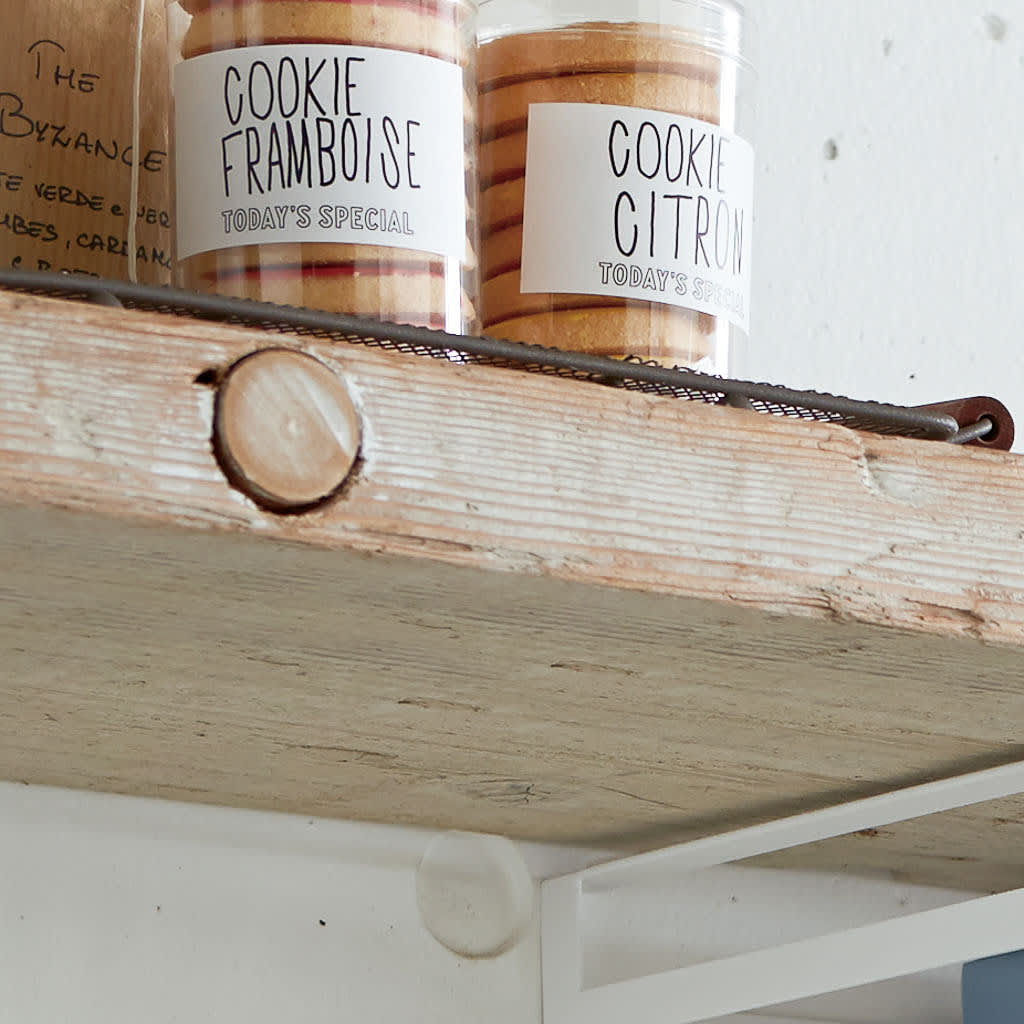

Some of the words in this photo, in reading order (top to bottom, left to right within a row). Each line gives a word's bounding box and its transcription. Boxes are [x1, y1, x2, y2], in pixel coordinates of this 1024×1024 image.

[28, 40, 100, 93] THE
[224, 56, 366, 126] COOKIE
[221, 115, 421, 198] FRAMBOISE
[608, 119, 730, 194] COOKIE
[221, 204, 311, 235] TODAY'S
[318, 205, 414, 235] SPECIAL
[614, 190, 744, 276] CITRON
[599, 262, 688, 296] TODAY'S
